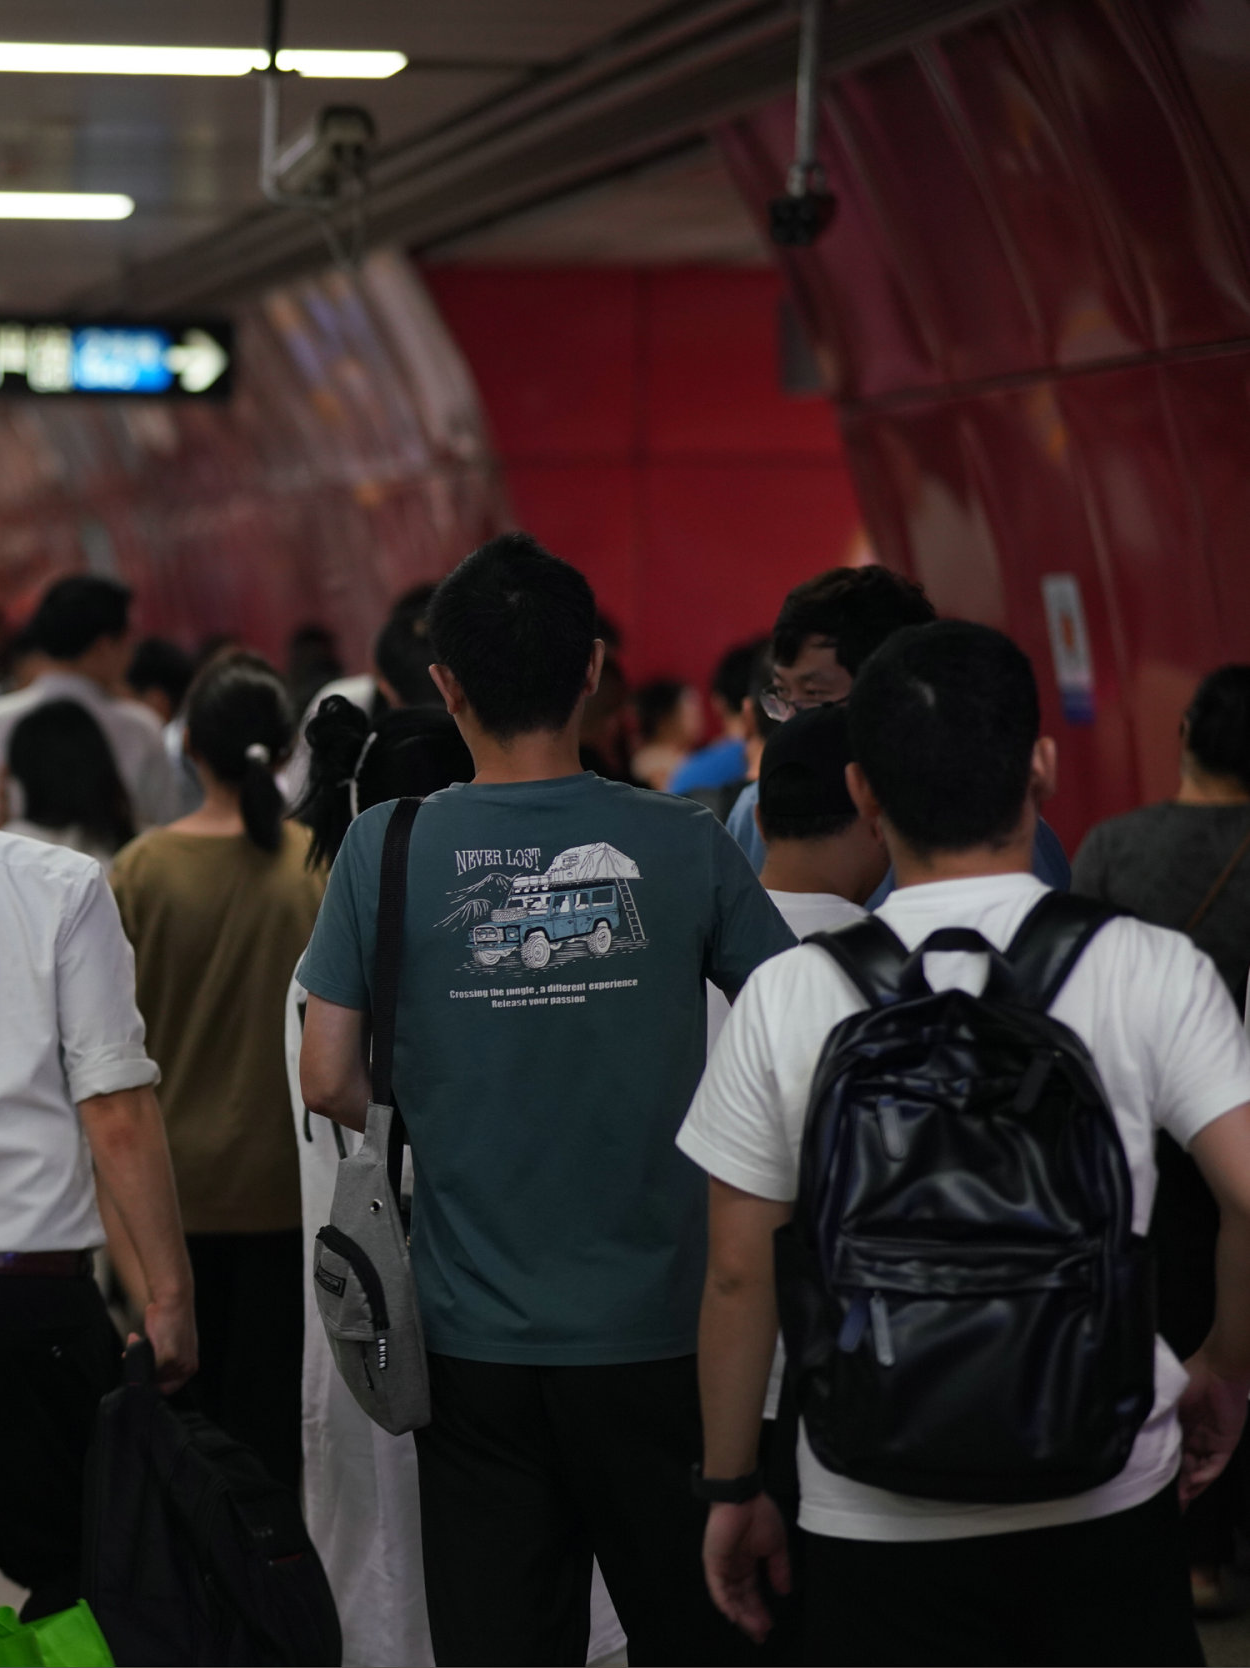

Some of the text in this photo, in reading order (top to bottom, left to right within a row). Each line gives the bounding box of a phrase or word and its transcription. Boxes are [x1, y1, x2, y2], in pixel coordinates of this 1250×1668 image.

[455, 847, 541, 876] NEVER LOST
[449, 989, 488, 999] Crossing
[490, 987, 505, 997] the
[539, 985, 546, 994] a
[547, 982, 586, 993] different
[589, 978, 639, 991] experience
[491, 995, 586, 1009] Release your passion
